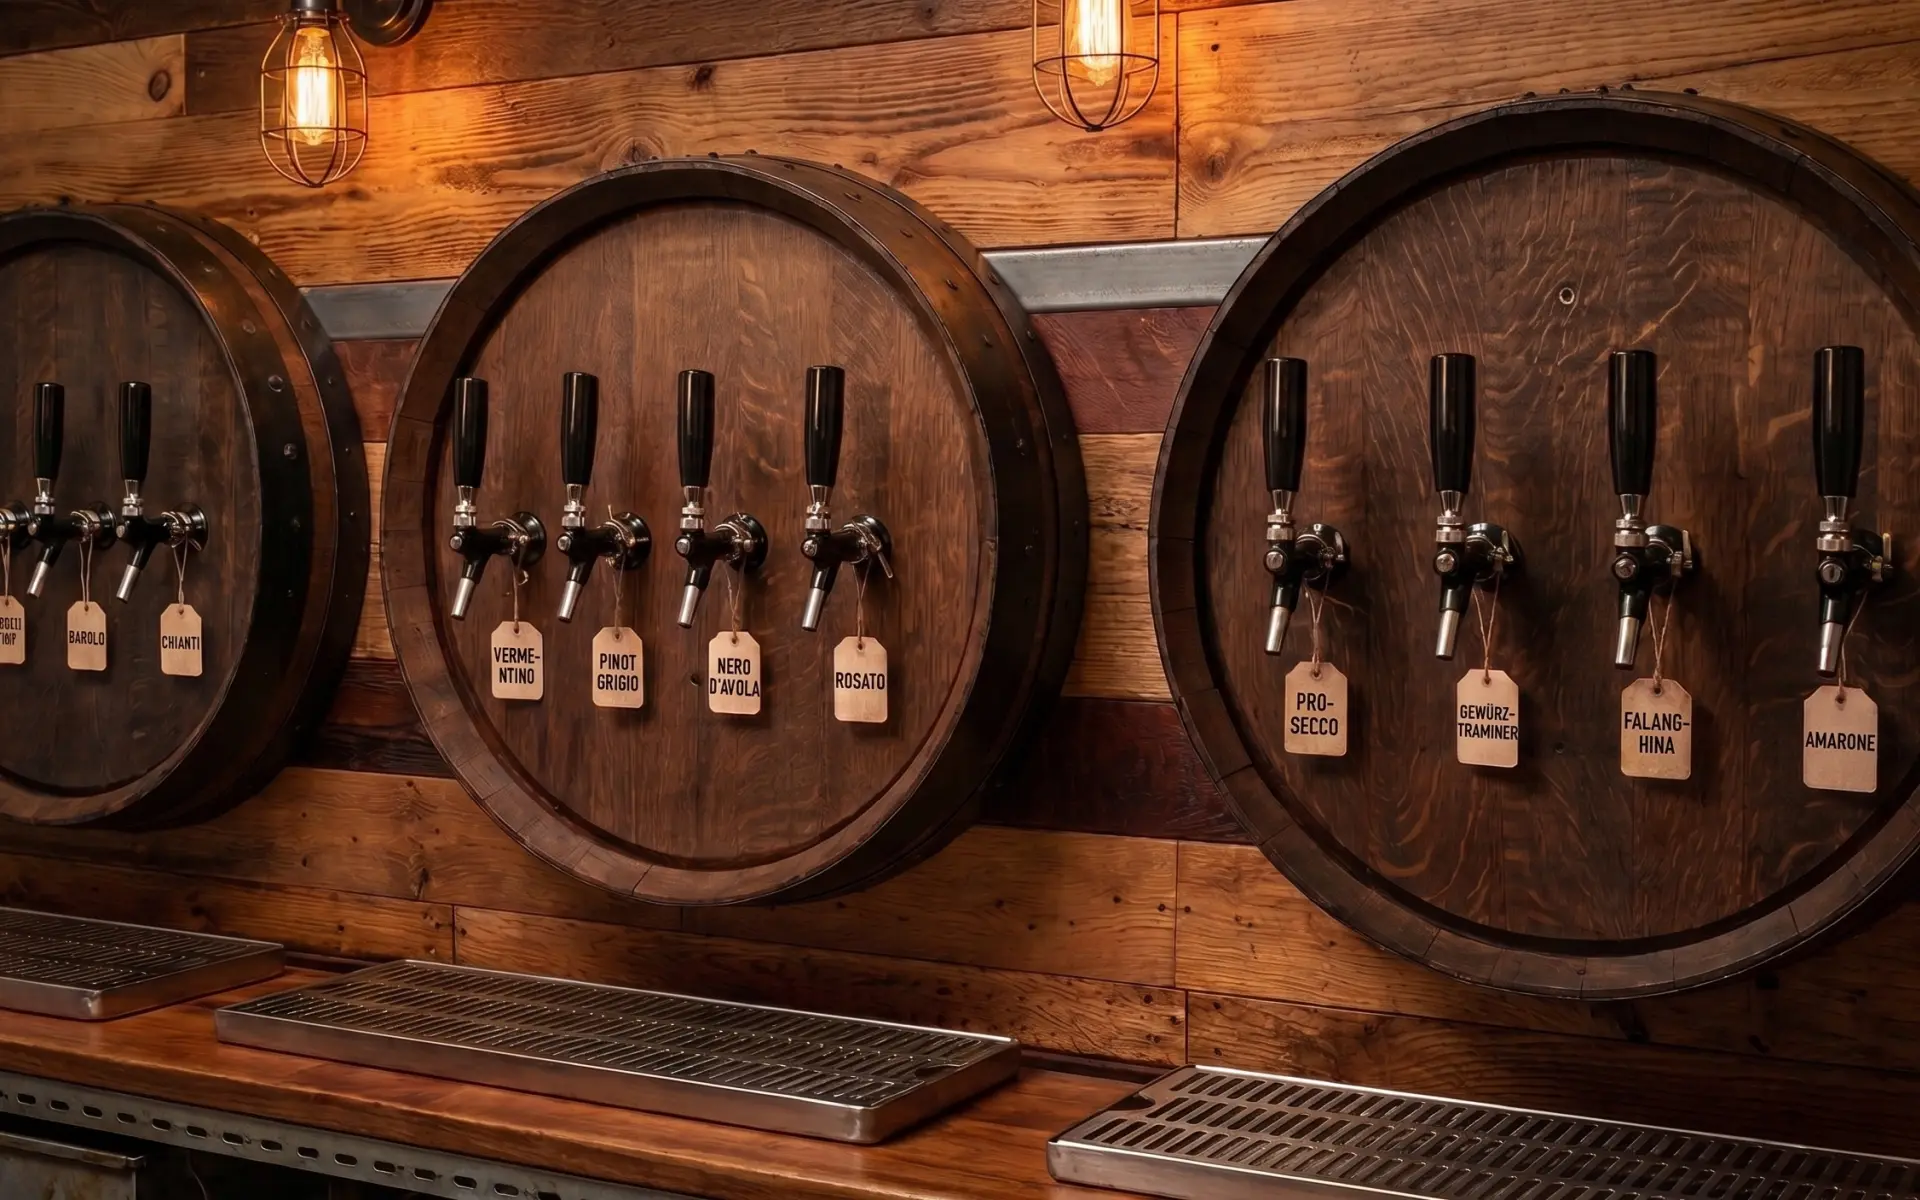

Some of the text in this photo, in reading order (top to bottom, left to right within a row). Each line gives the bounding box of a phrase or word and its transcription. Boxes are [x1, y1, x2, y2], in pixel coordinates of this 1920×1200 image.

[69, 630, 105, 646] BAROLO
[162, 635, 200, 651] CHIANTI
[494, 647, 540, 664] VERME-
[600, 653, 637, 671] PINOT
[718, 658, 751, 675] NERO
[499, 668, 534, 684] NTINO
[597, 674, 639, 691] GRIGIO
[835, 672, 885, 690] ROSATO
[709, 678, 760, 697] D'AVOLA
[1296, 692, 1334, 712] PRO-
[1460, 703, 1516, 721] GEWÜRZ-
[1290, 716, 1339, 736] SECCO
[1624, 711, 1690, 732] FALANG-
[1458, 722, 1519, 740] TRAMINER
[1639, 735, 1675, 754] HINA
[1805, 731, 1876, 752] AMARONE
